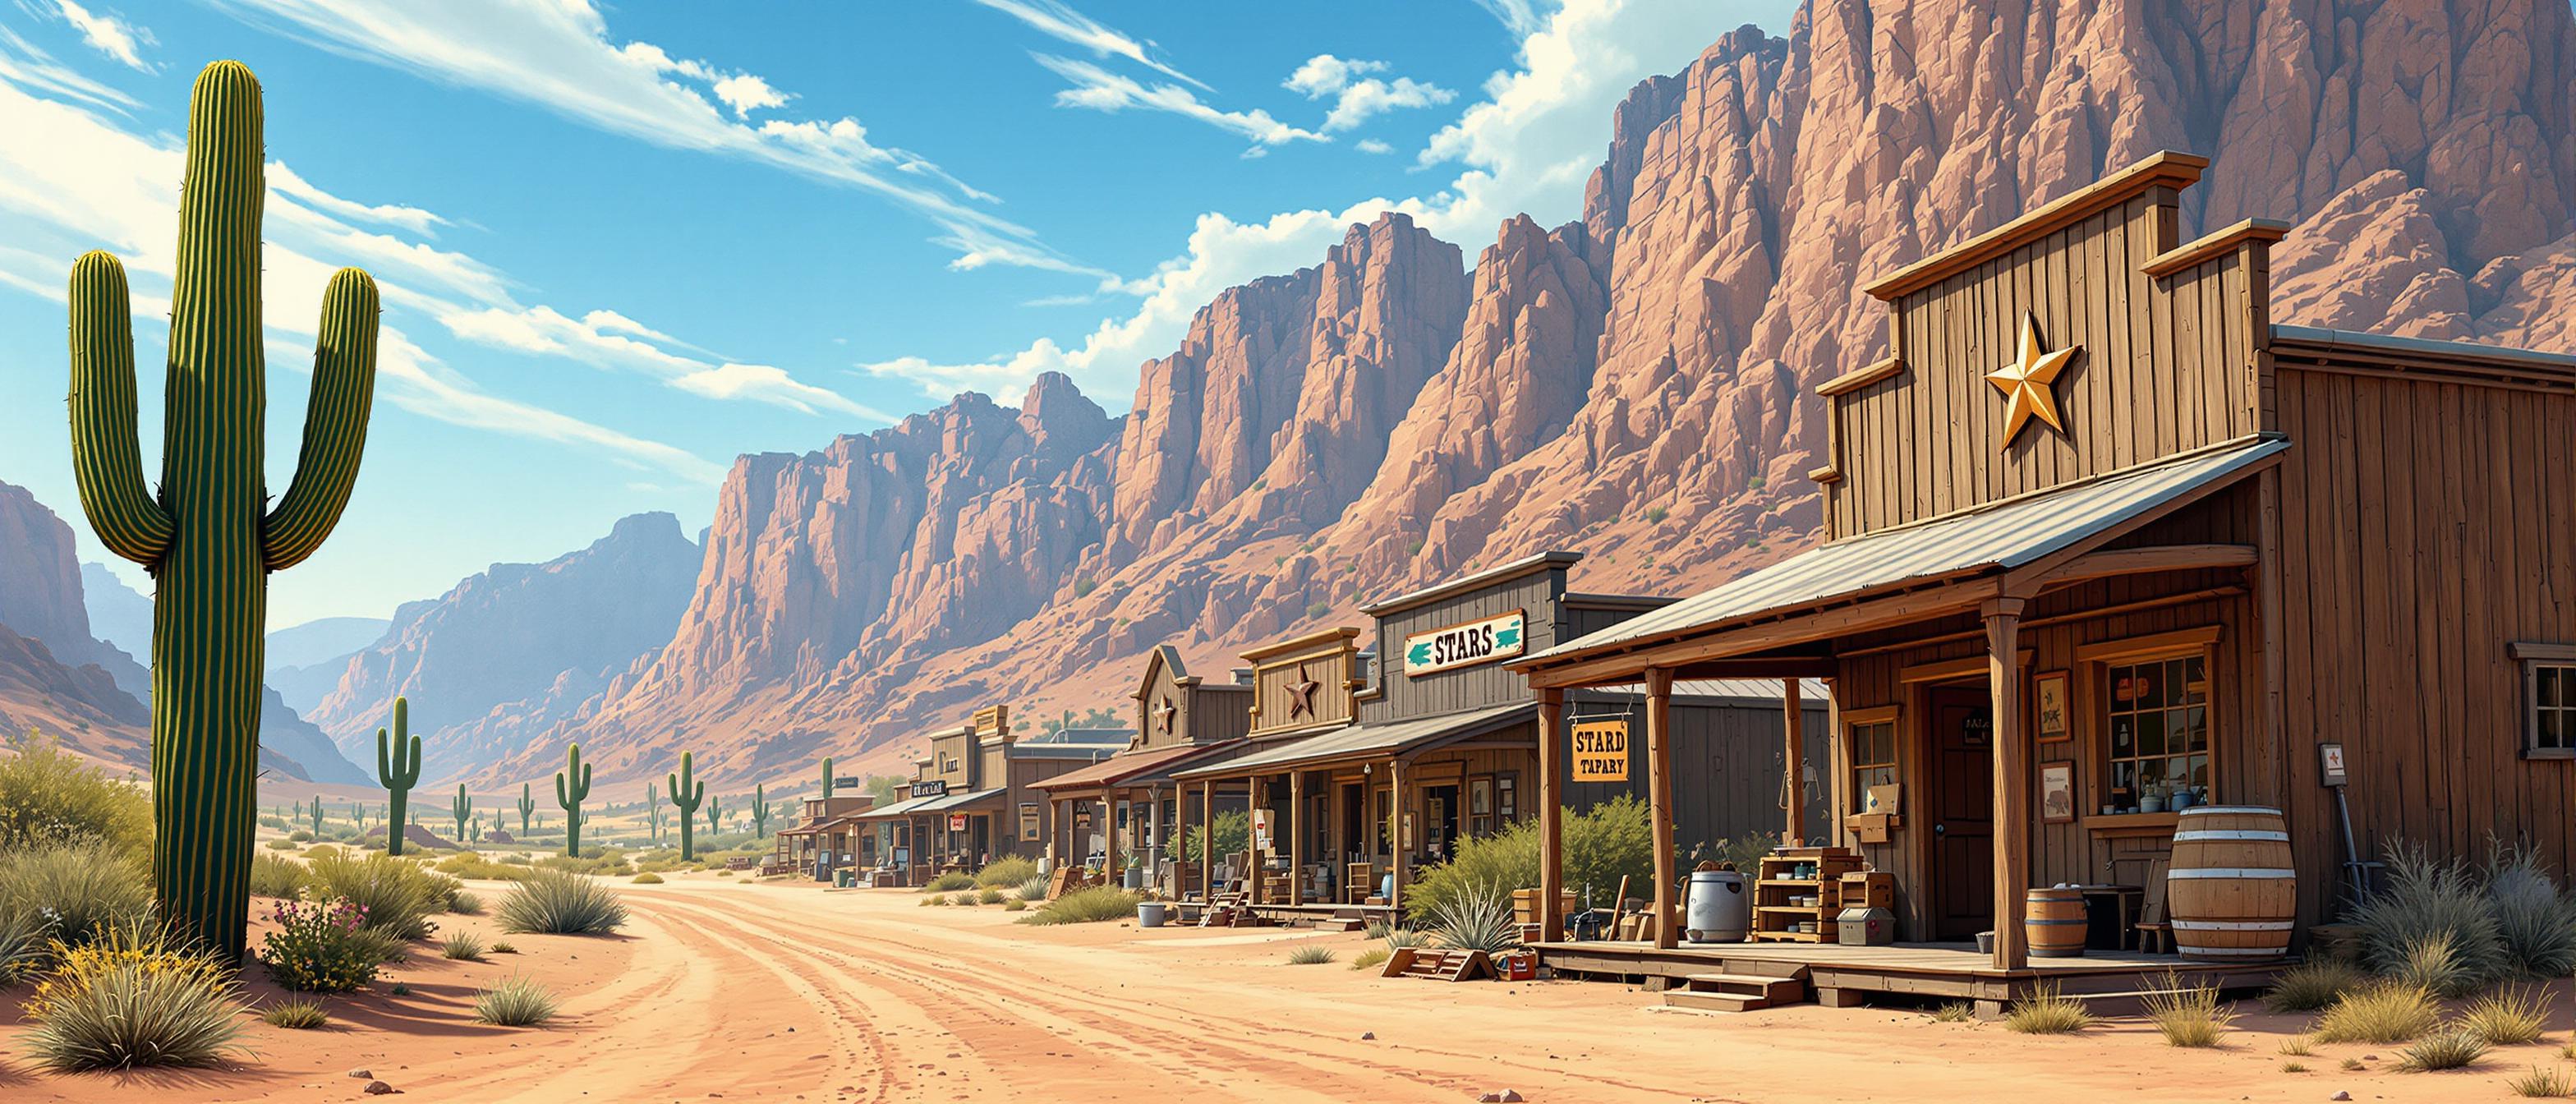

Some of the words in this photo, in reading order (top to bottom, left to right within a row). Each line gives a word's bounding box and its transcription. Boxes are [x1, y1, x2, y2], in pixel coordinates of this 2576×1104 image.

[1435, 624, 1493, 665] STARS
[1576, 731, 1625, 752] STARD
[1580, 759, 1625, 774] TAPARY
